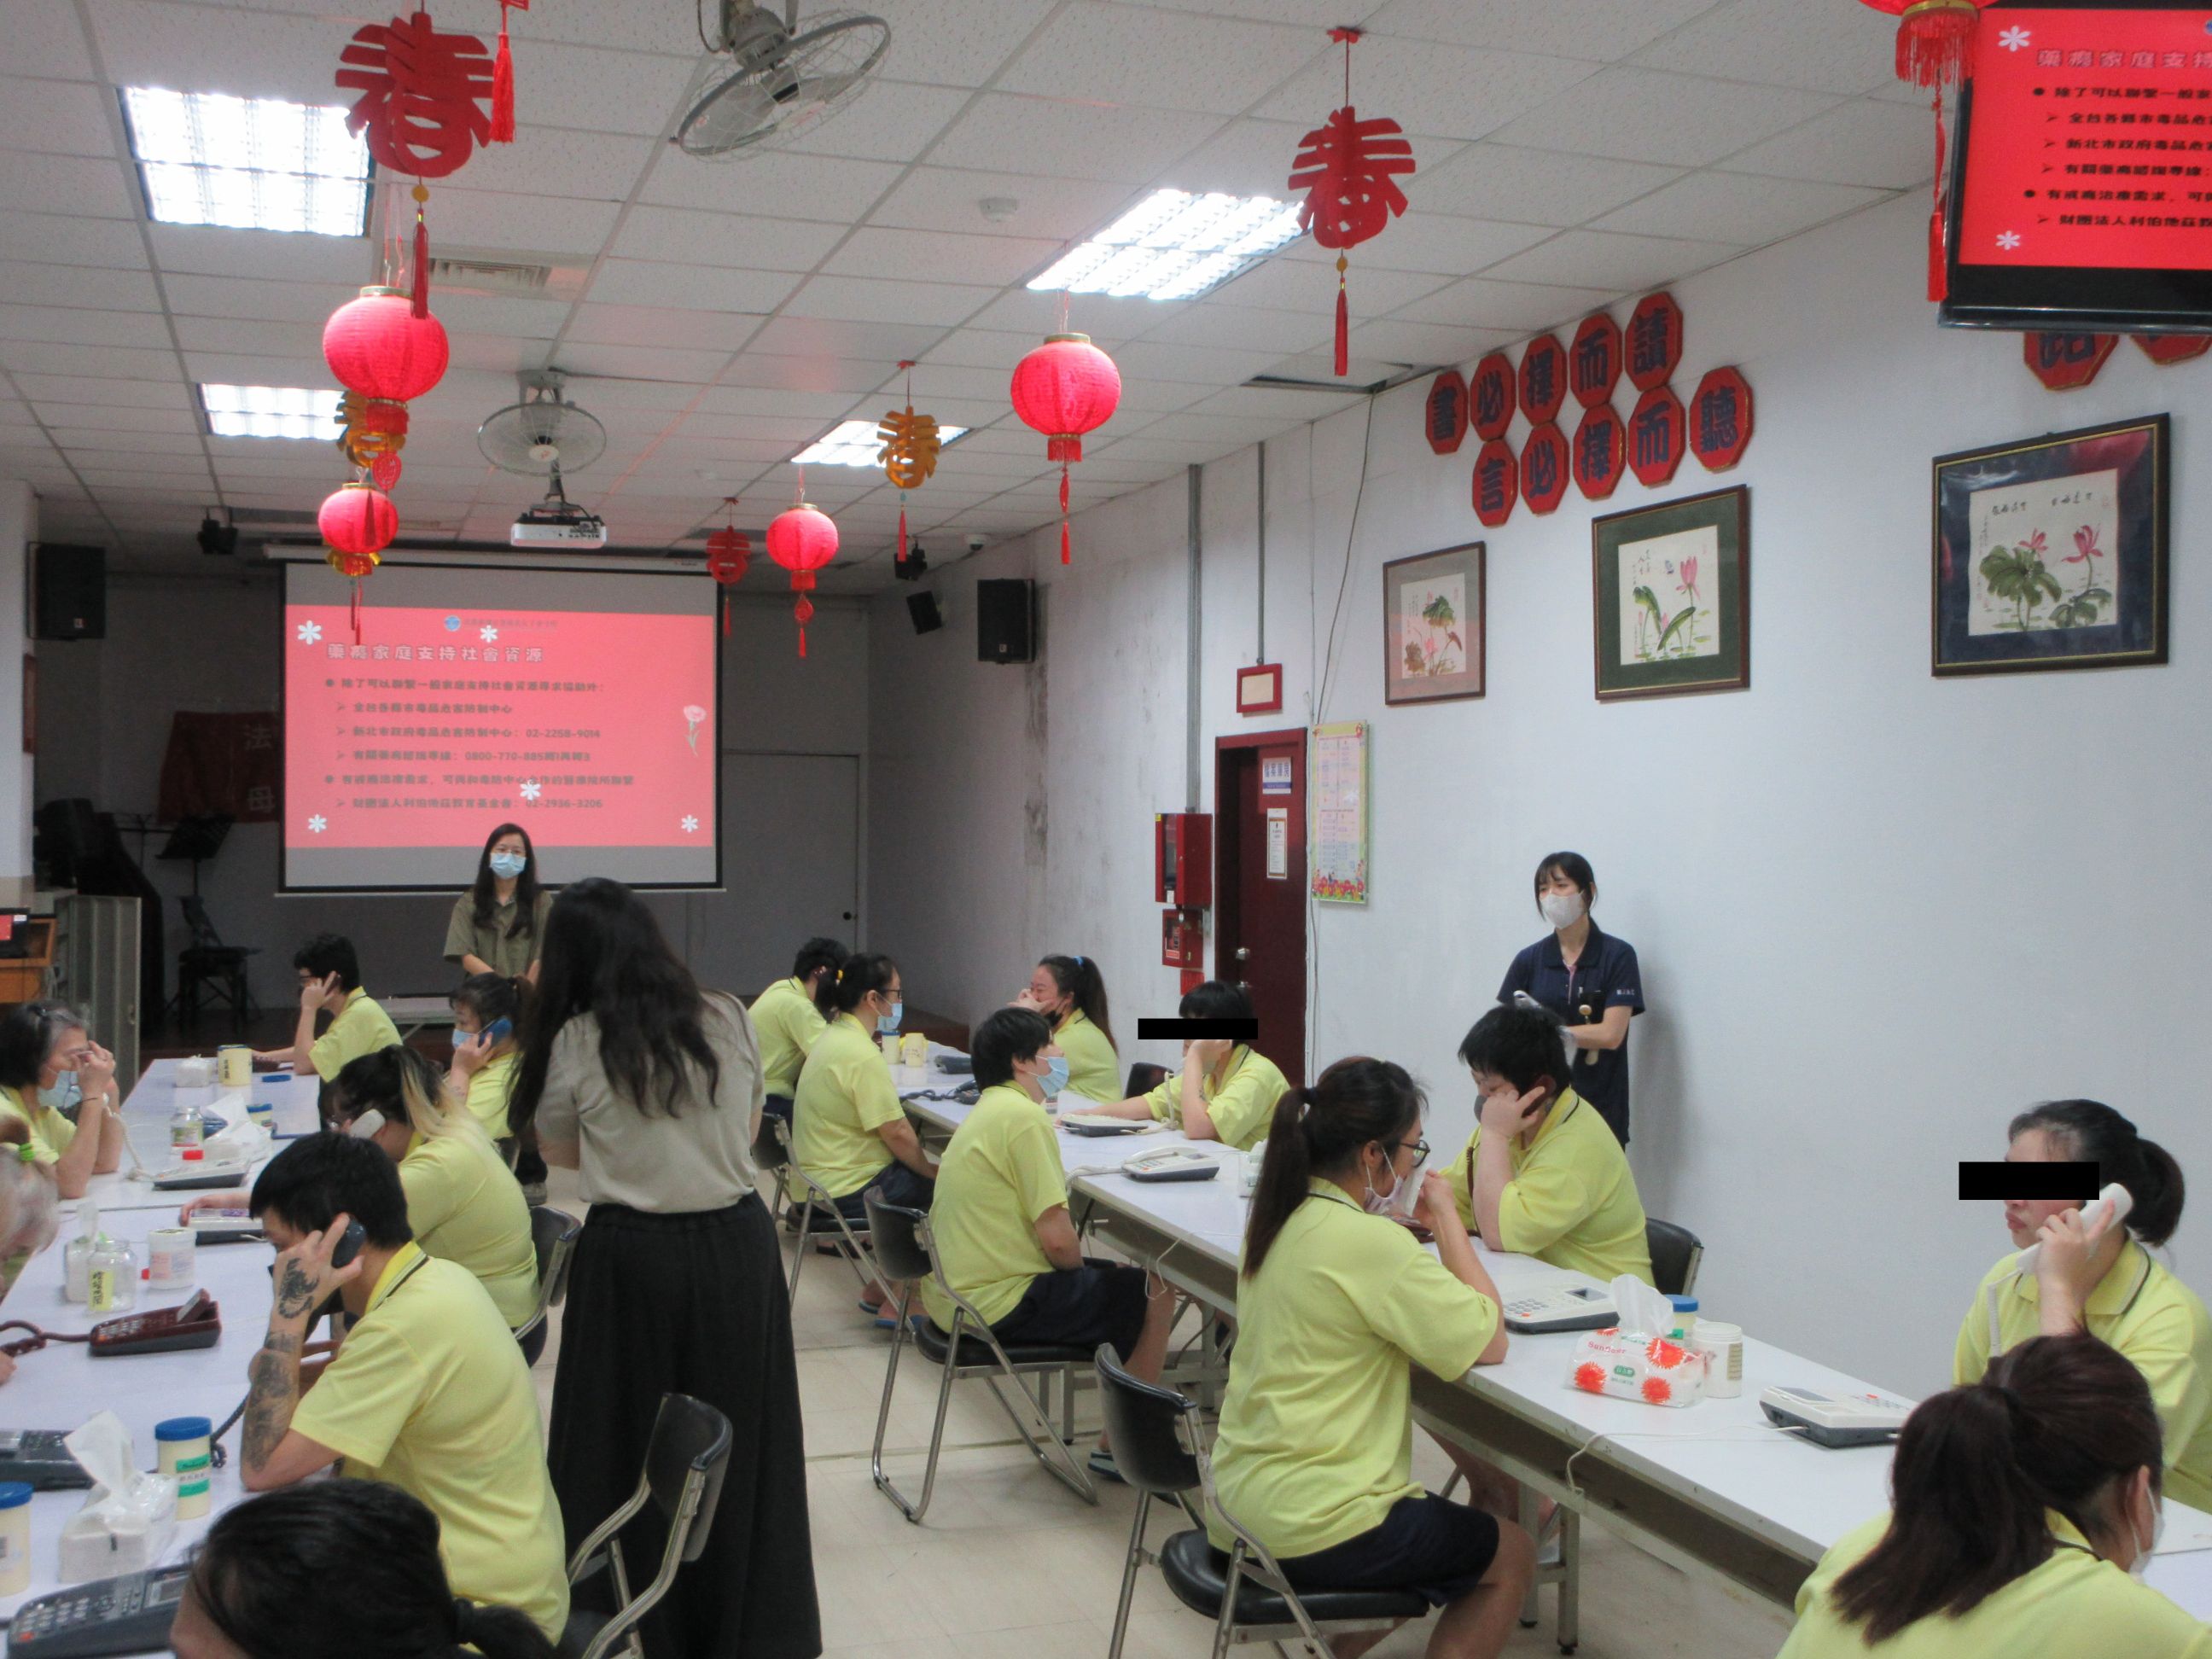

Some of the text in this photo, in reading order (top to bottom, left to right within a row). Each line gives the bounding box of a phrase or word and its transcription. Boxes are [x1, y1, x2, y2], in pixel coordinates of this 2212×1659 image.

[2069, 113, 2212, 125] 全台各縣市毒品危
